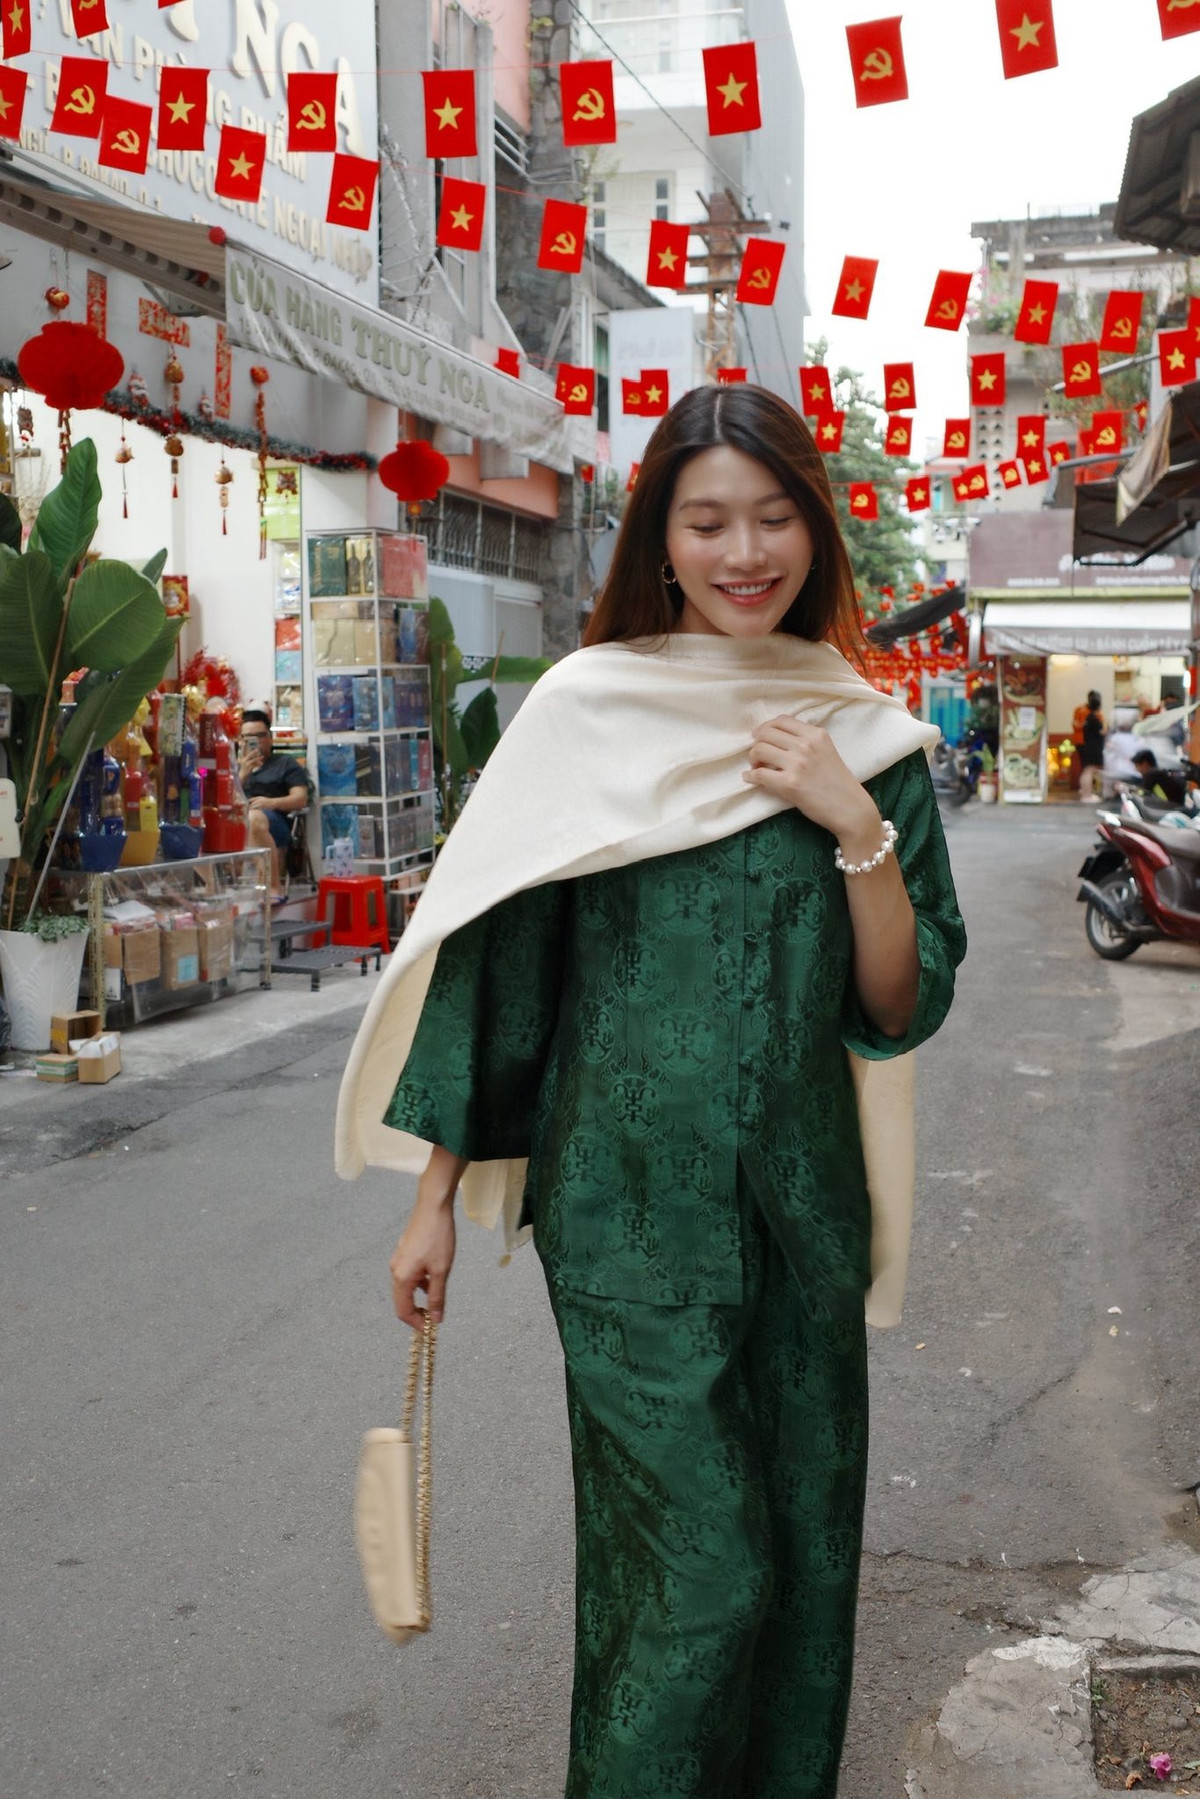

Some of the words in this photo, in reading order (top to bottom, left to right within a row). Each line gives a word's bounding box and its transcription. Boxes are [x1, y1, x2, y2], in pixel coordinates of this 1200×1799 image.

[230, 256, 280, 319] CỬA
[286, 281, 343, 347] HÀNG
[439, 355, 490, 413] NGA
